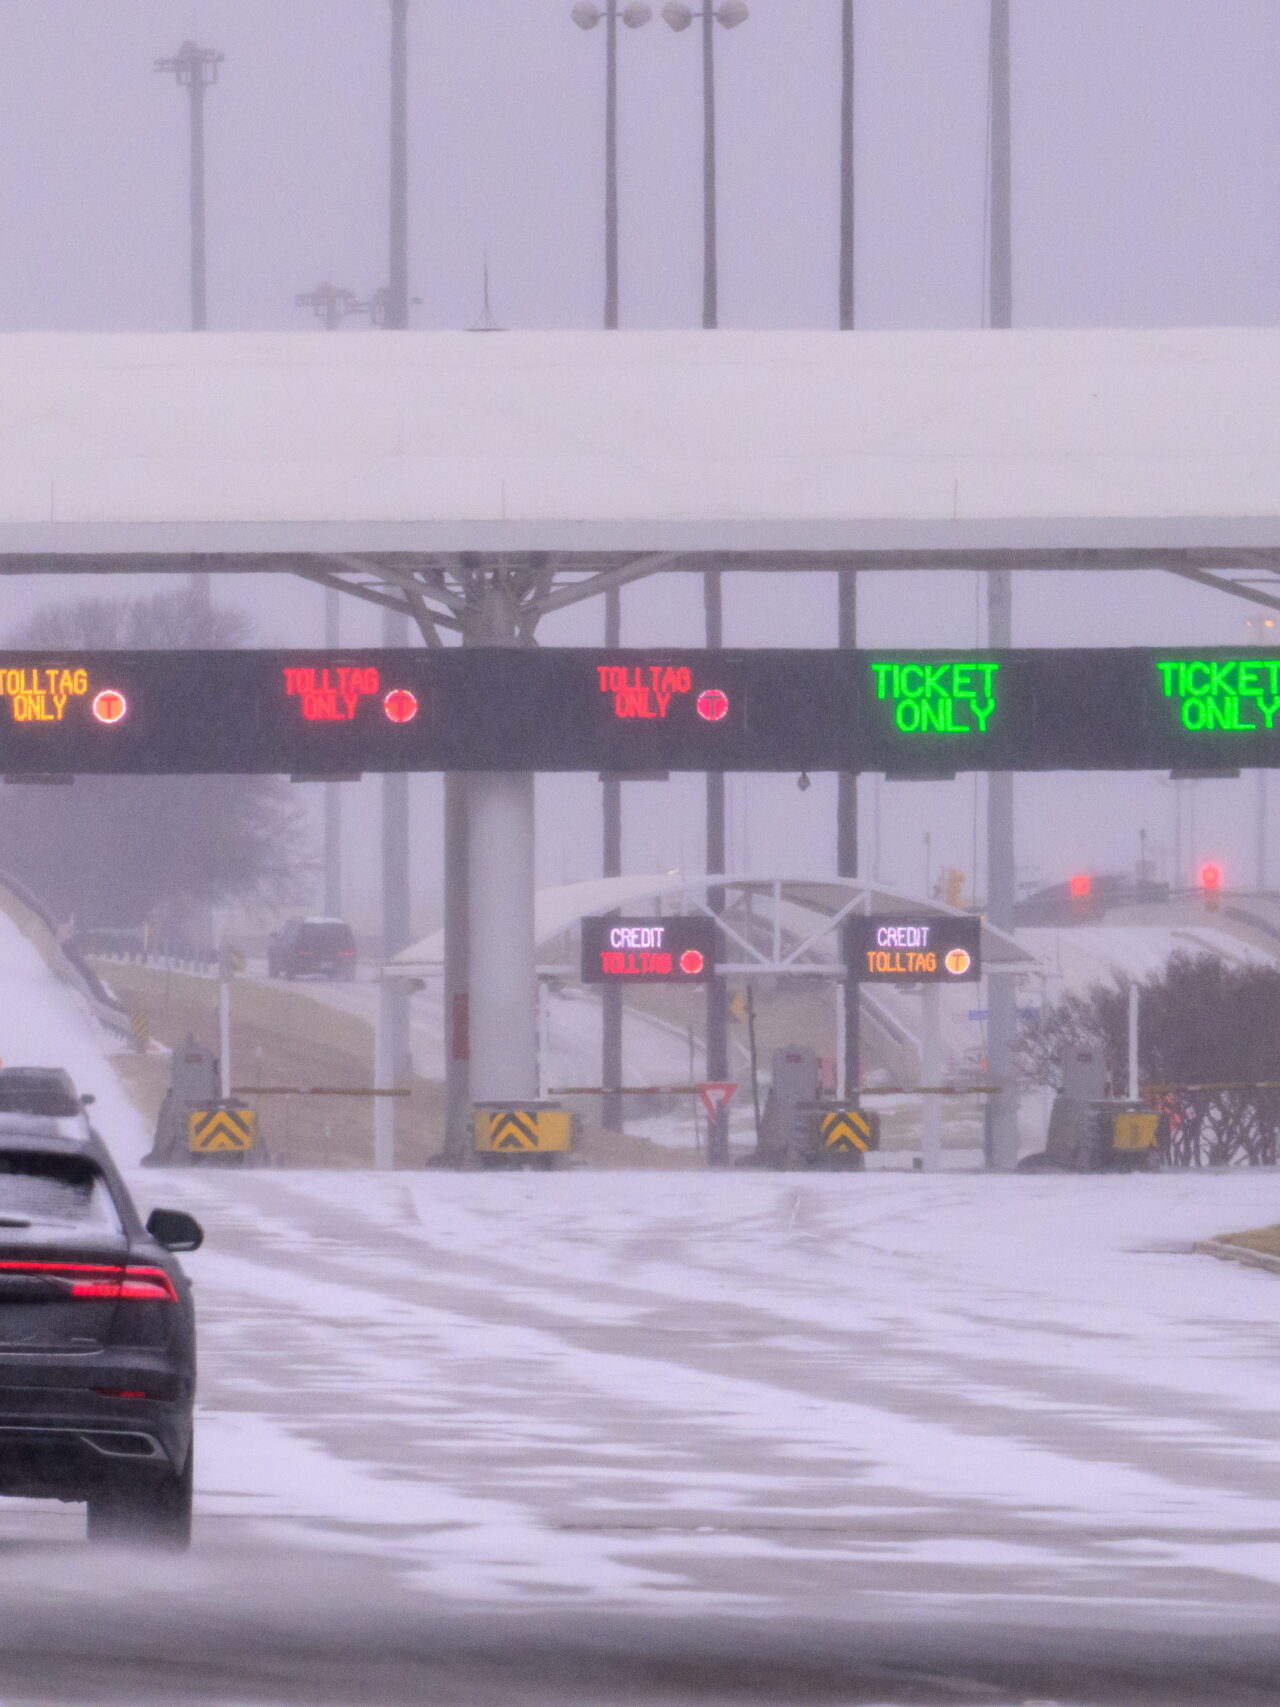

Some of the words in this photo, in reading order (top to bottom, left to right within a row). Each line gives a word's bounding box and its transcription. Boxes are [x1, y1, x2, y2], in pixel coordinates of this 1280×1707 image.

[871, 663, 1000, 699] TICKET
[1156, 660, 1280, 697] TICKET
[13, 694, 67, 722] ONLY
[302, 692, 359, 721] ONLY
[615, 689, 670, 718] ONLY
[895, 697, 996, 733] ONLY
[1181, 695, 1280, 731] ONLY
[610, 927, 664, 949] CREDIT
[877, 926, 930, 948] CREDIT
